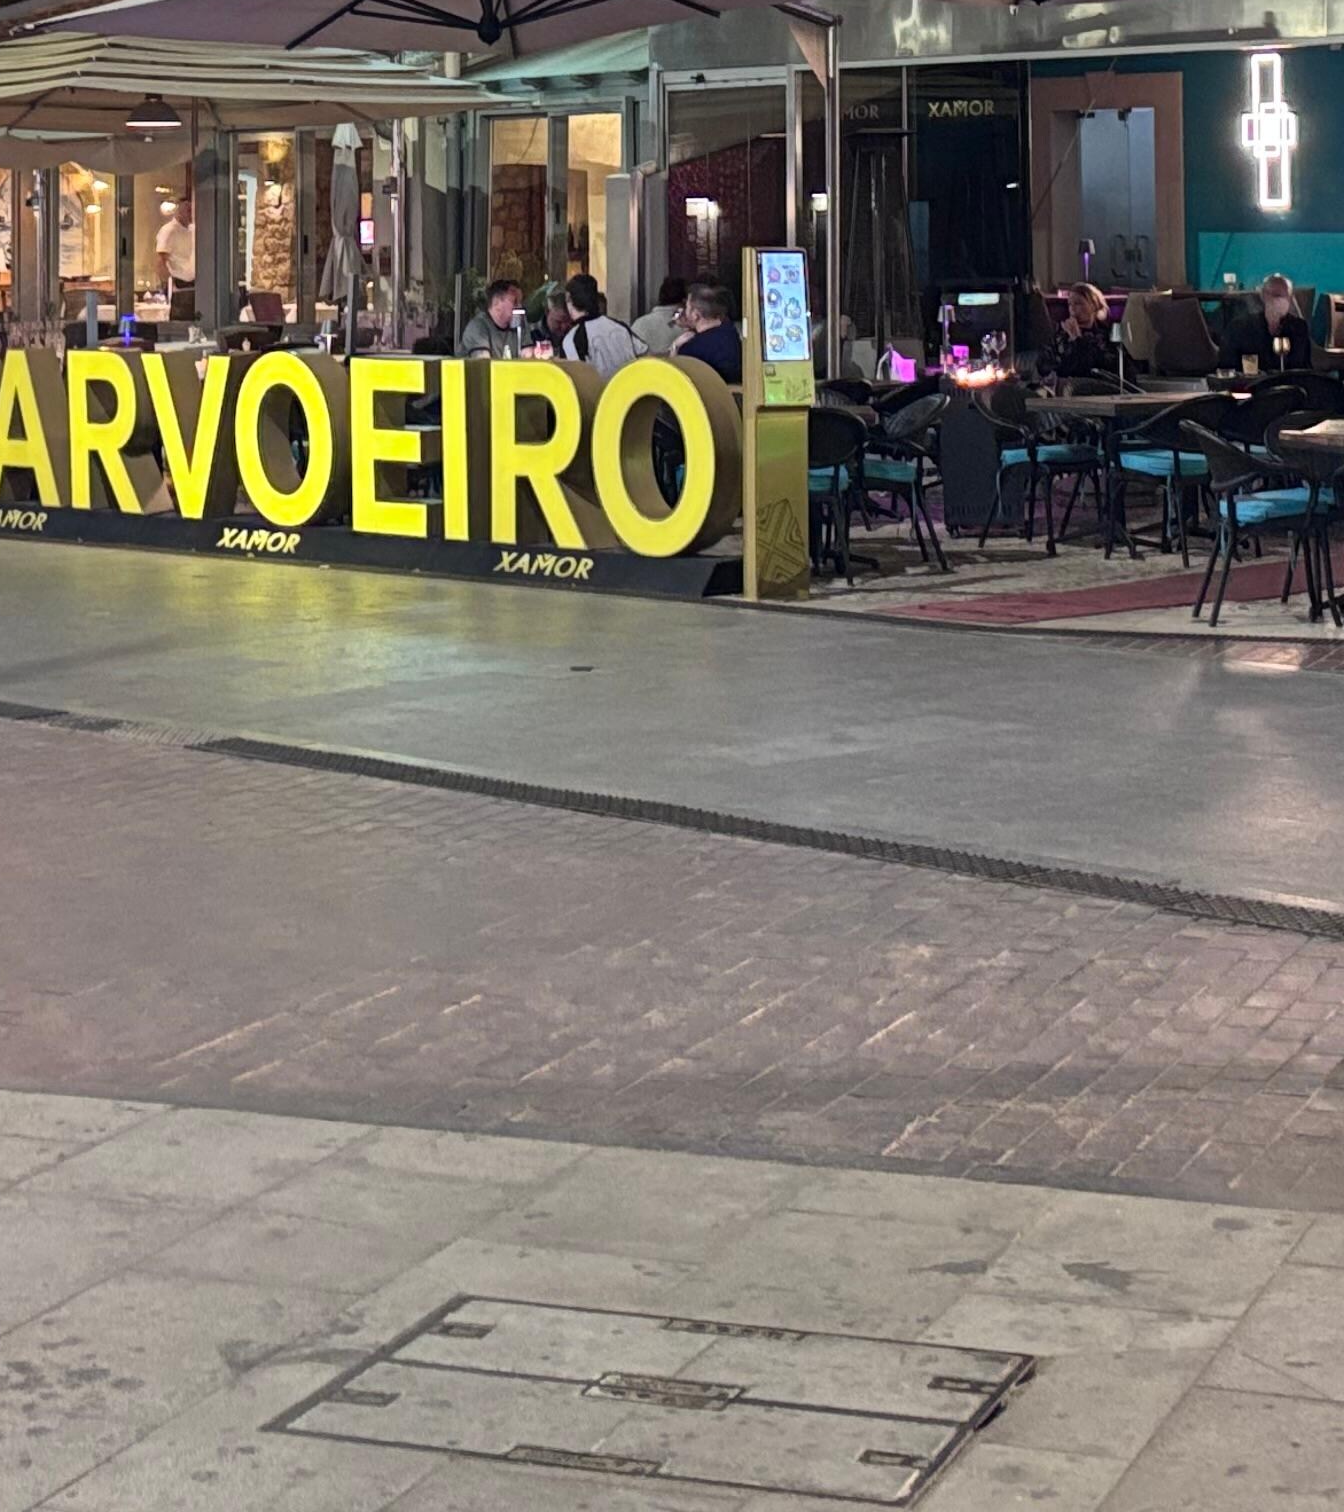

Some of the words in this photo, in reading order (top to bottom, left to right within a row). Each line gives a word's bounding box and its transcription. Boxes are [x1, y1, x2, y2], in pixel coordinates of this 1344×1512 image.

[840, 104, 879, 121] MOR
[927, 99, 995, 118] XAMOR
[216, 527, 301, 554] XAMOR
[493, 551, 594, 580] XAMOR
